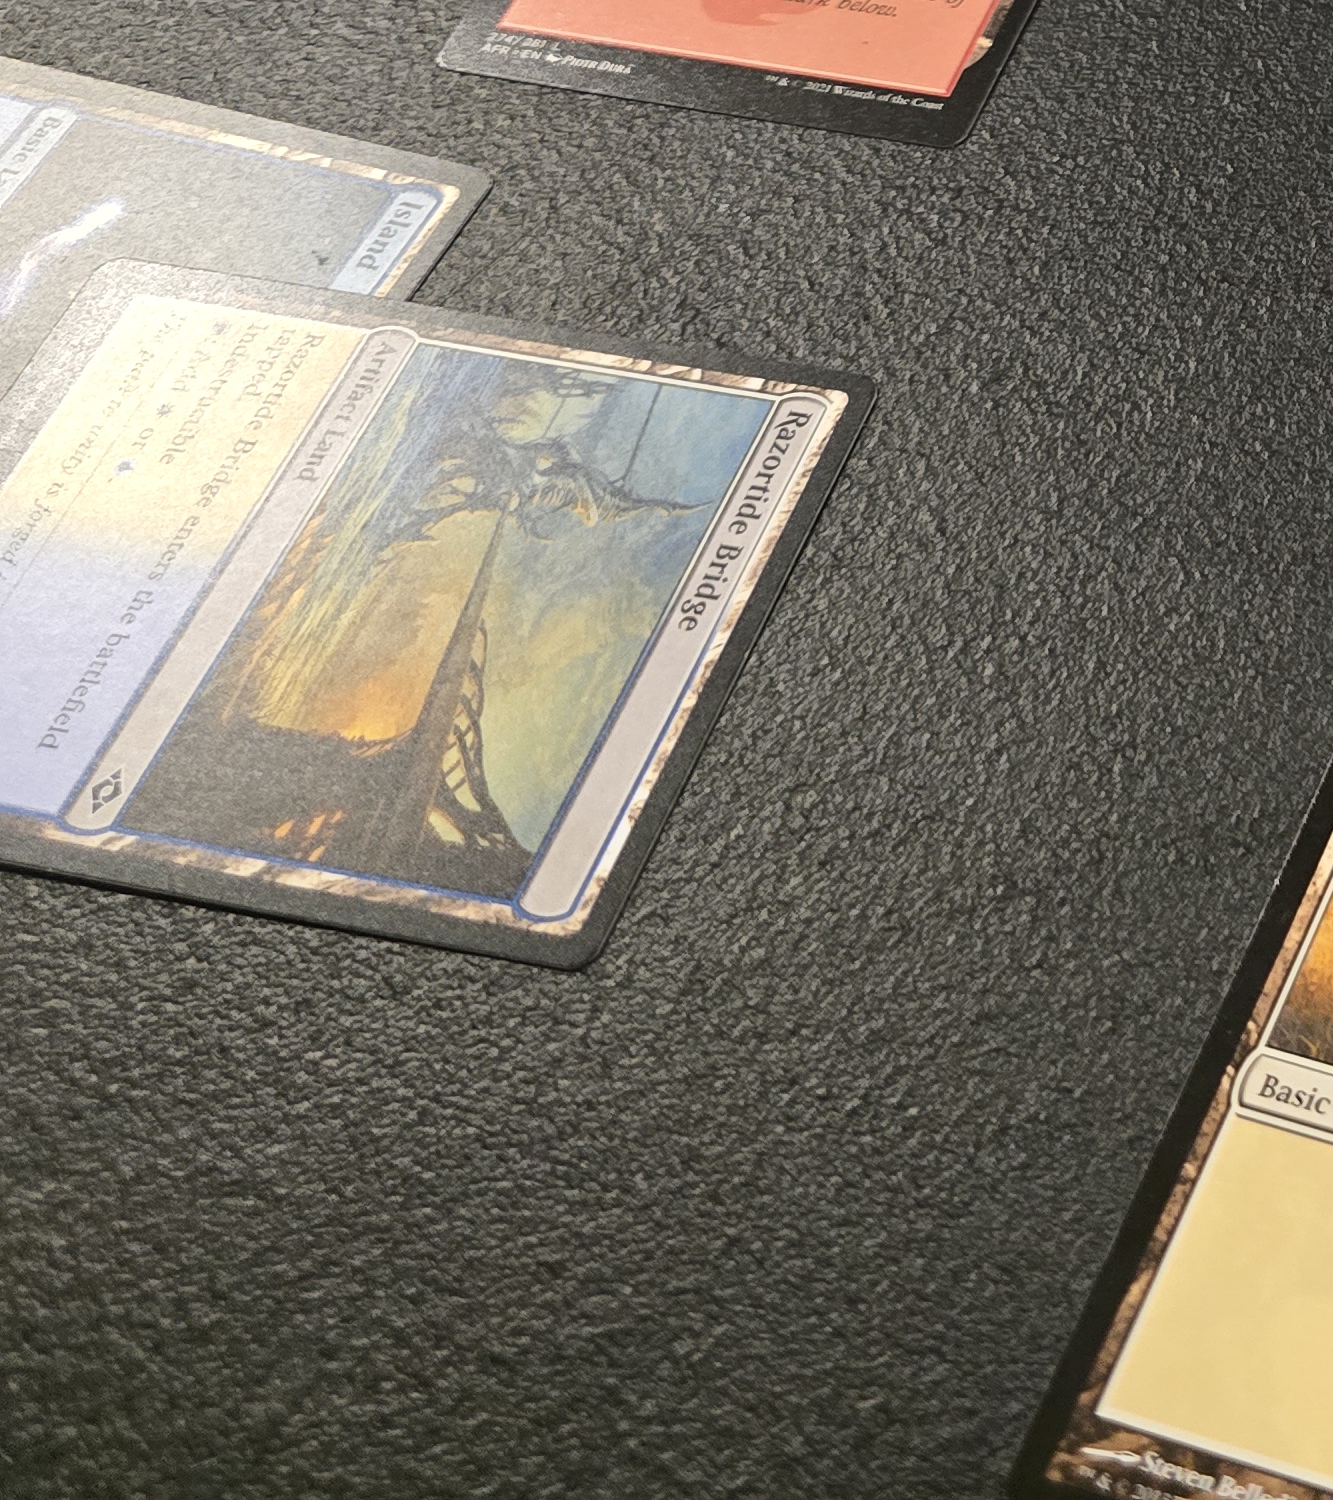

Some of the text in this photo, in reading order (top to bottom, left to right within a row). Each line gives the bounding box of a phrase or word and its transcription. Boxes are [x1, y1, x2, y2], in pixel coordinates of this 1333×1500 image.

[357, 201, 423, 271] Island
[292, 341, 400, 483] Artifact Land
[34, 331, 326, 749] Razortide Bridge enters the battlefield
[668, 408, 814, 633] Razortide Bridge
[1255, 1073, 1333, 1116] Basic
